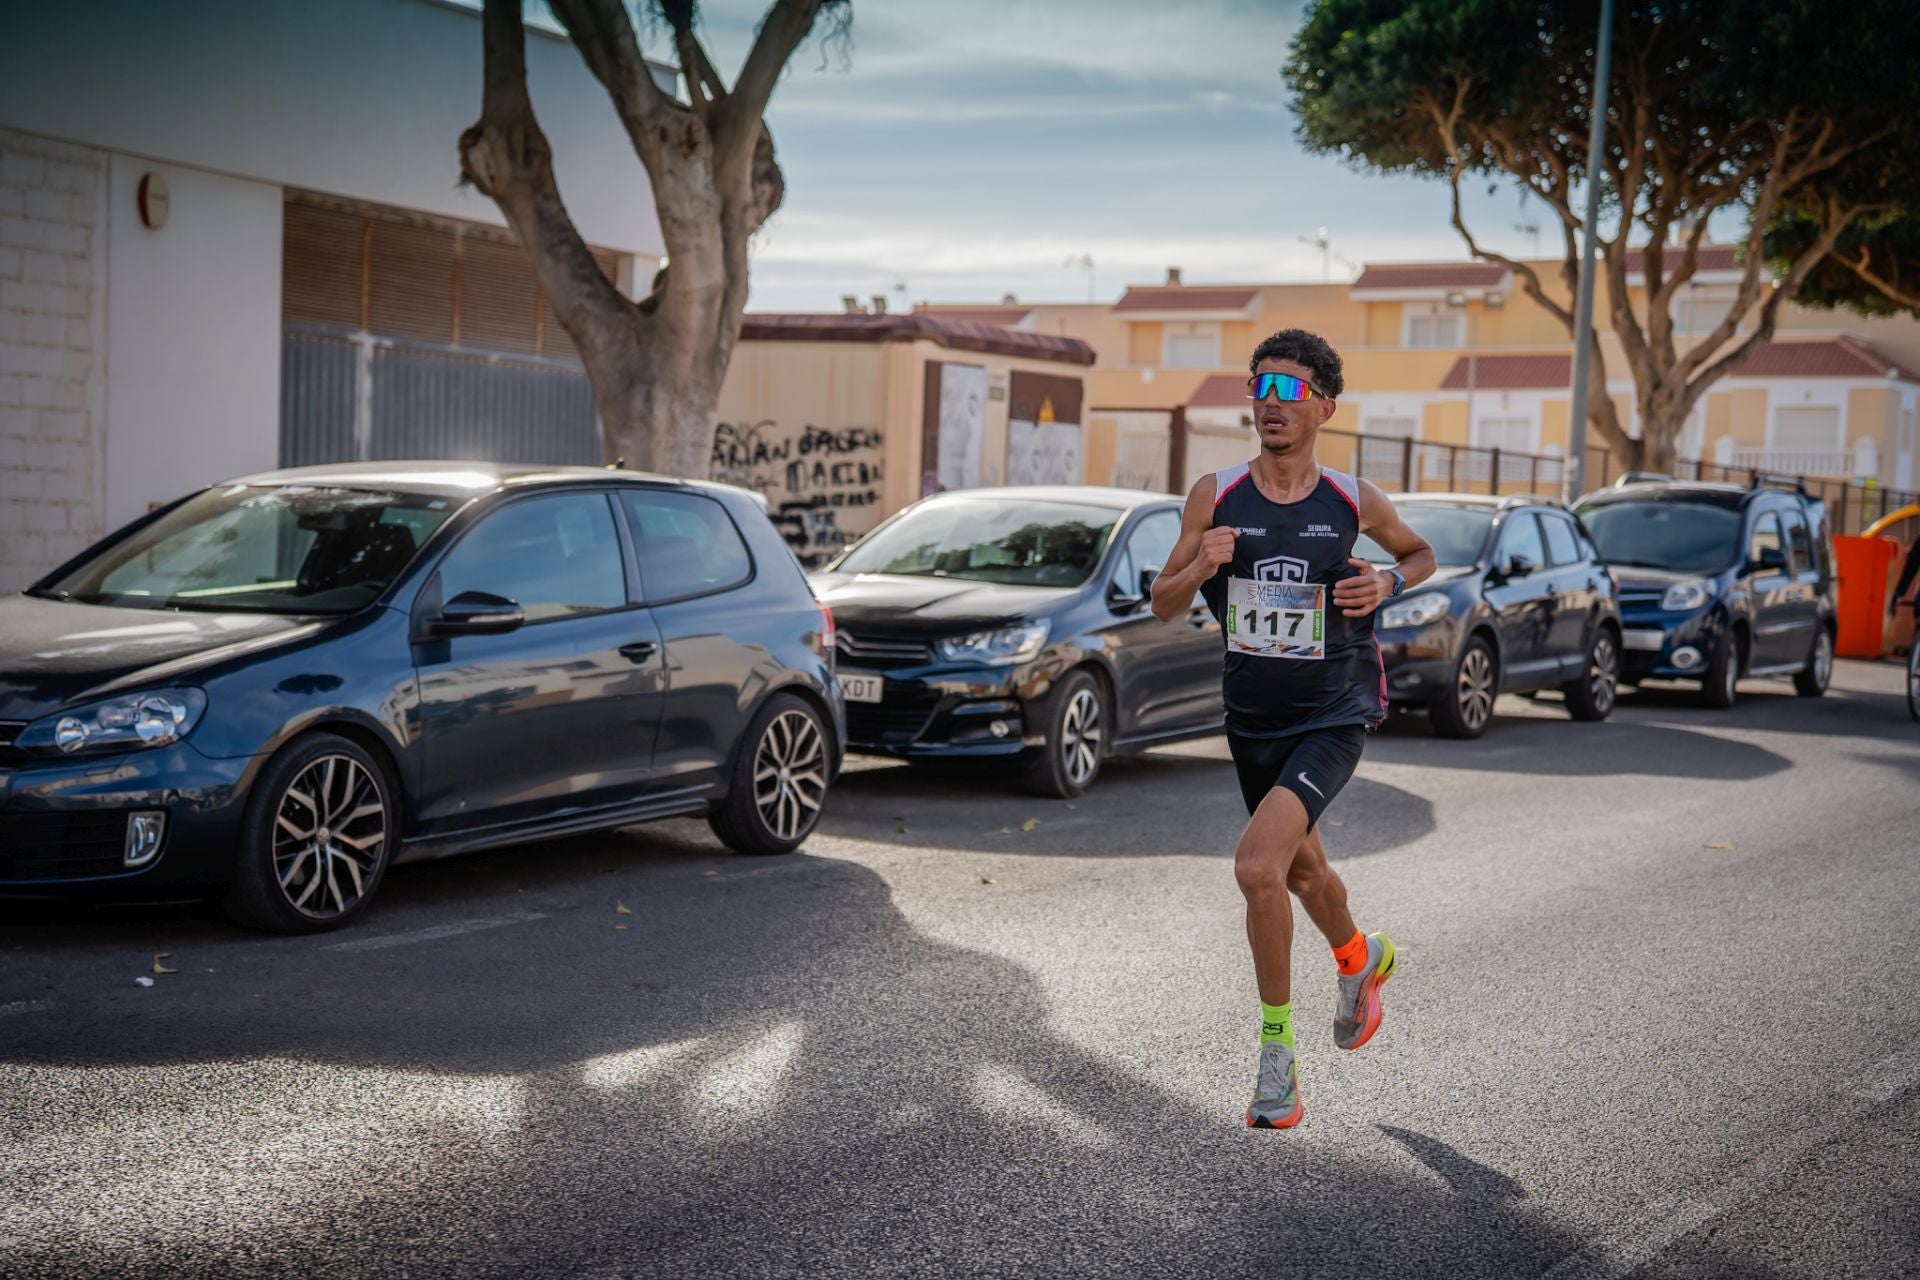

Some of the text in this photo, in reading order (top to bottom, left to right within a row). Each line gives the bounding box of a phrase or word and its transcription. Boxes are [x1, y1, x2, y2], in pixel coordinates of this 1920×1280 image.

[1307, 524, 1332, 532] SEGURA
[1256, 584, 1293, 598] MEDIA
[1243, 609, 1305, 637] 117
[842, 680, 875, 698] KDT
